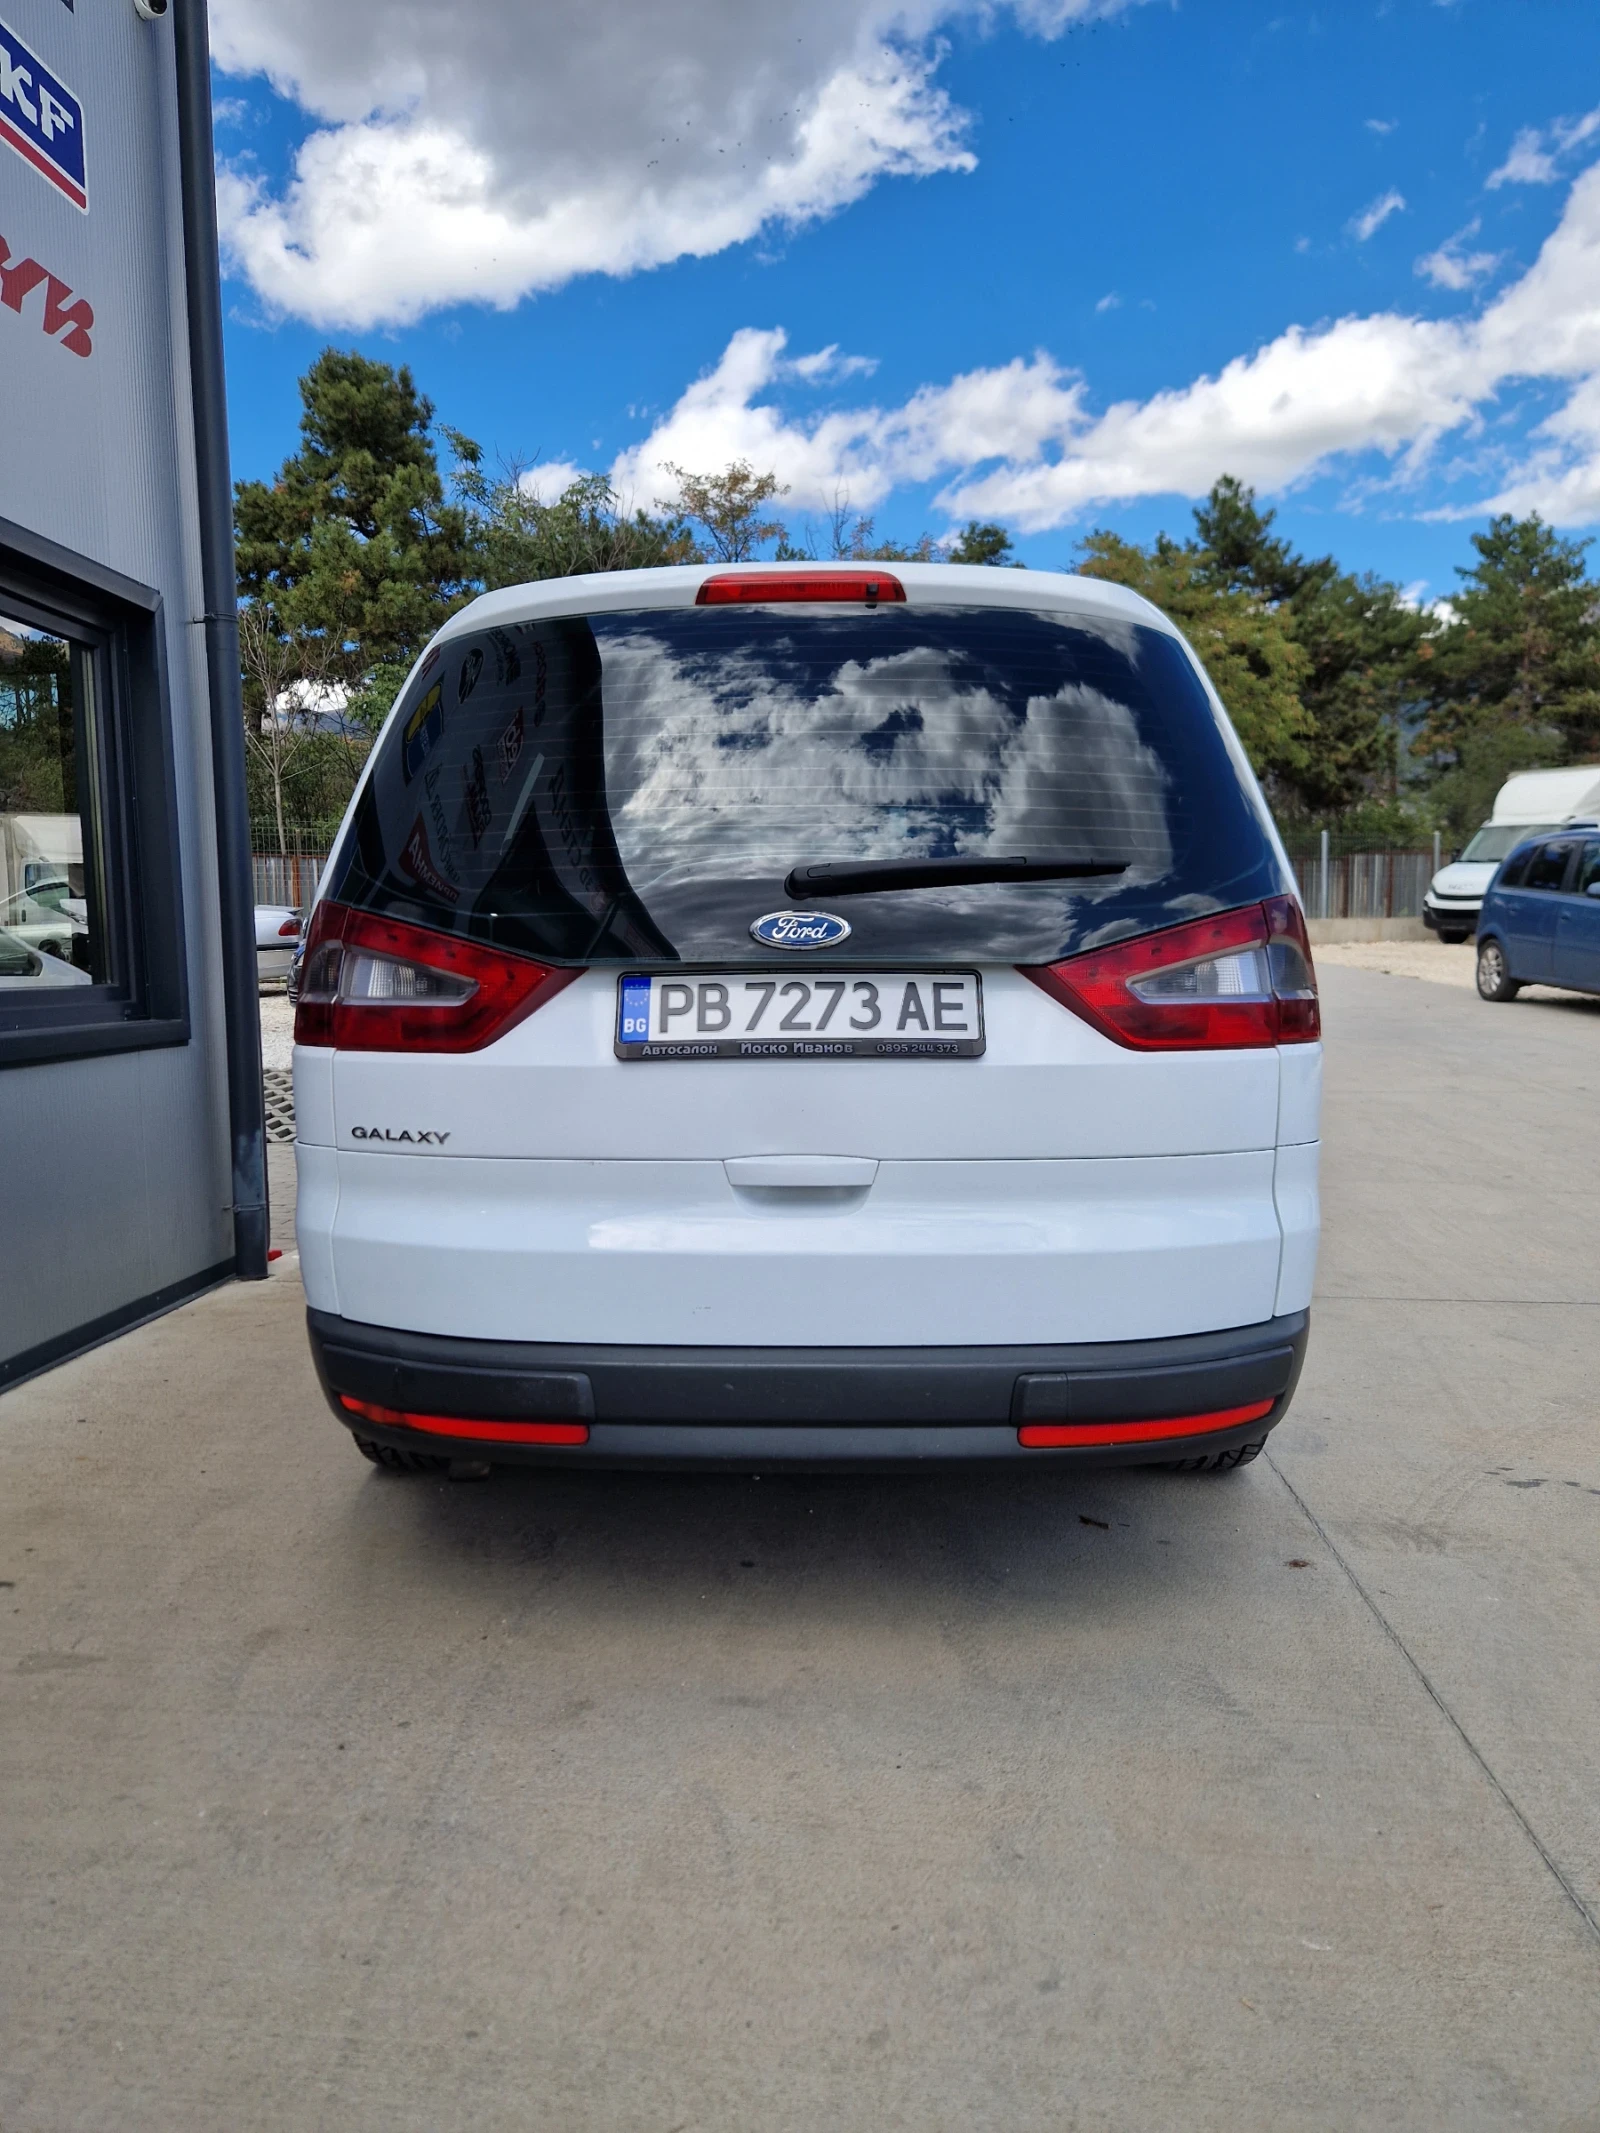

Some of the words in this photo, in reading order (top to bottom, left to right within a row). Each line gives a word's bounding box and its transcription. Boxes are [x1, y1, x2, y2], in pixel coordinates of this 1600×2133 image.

[772, 916, 828, 940] Ford
[658, 983, 731, 1033] PB
[744, 981, 881, 1032] 7273
[897, 982, 968, 1031] AE
[624, 1019, 647, 1033] BG
[642, 1045, 717, 1056] Автосалон
[793, 1043, 853, 1054] Иванов
[877, 1044, 908, 1053] 0895
[911, 1044, 934, 1053] 244
[937, 1044, 959, 1053] 373
[352, 1127, 451, 1144] GALAXY
